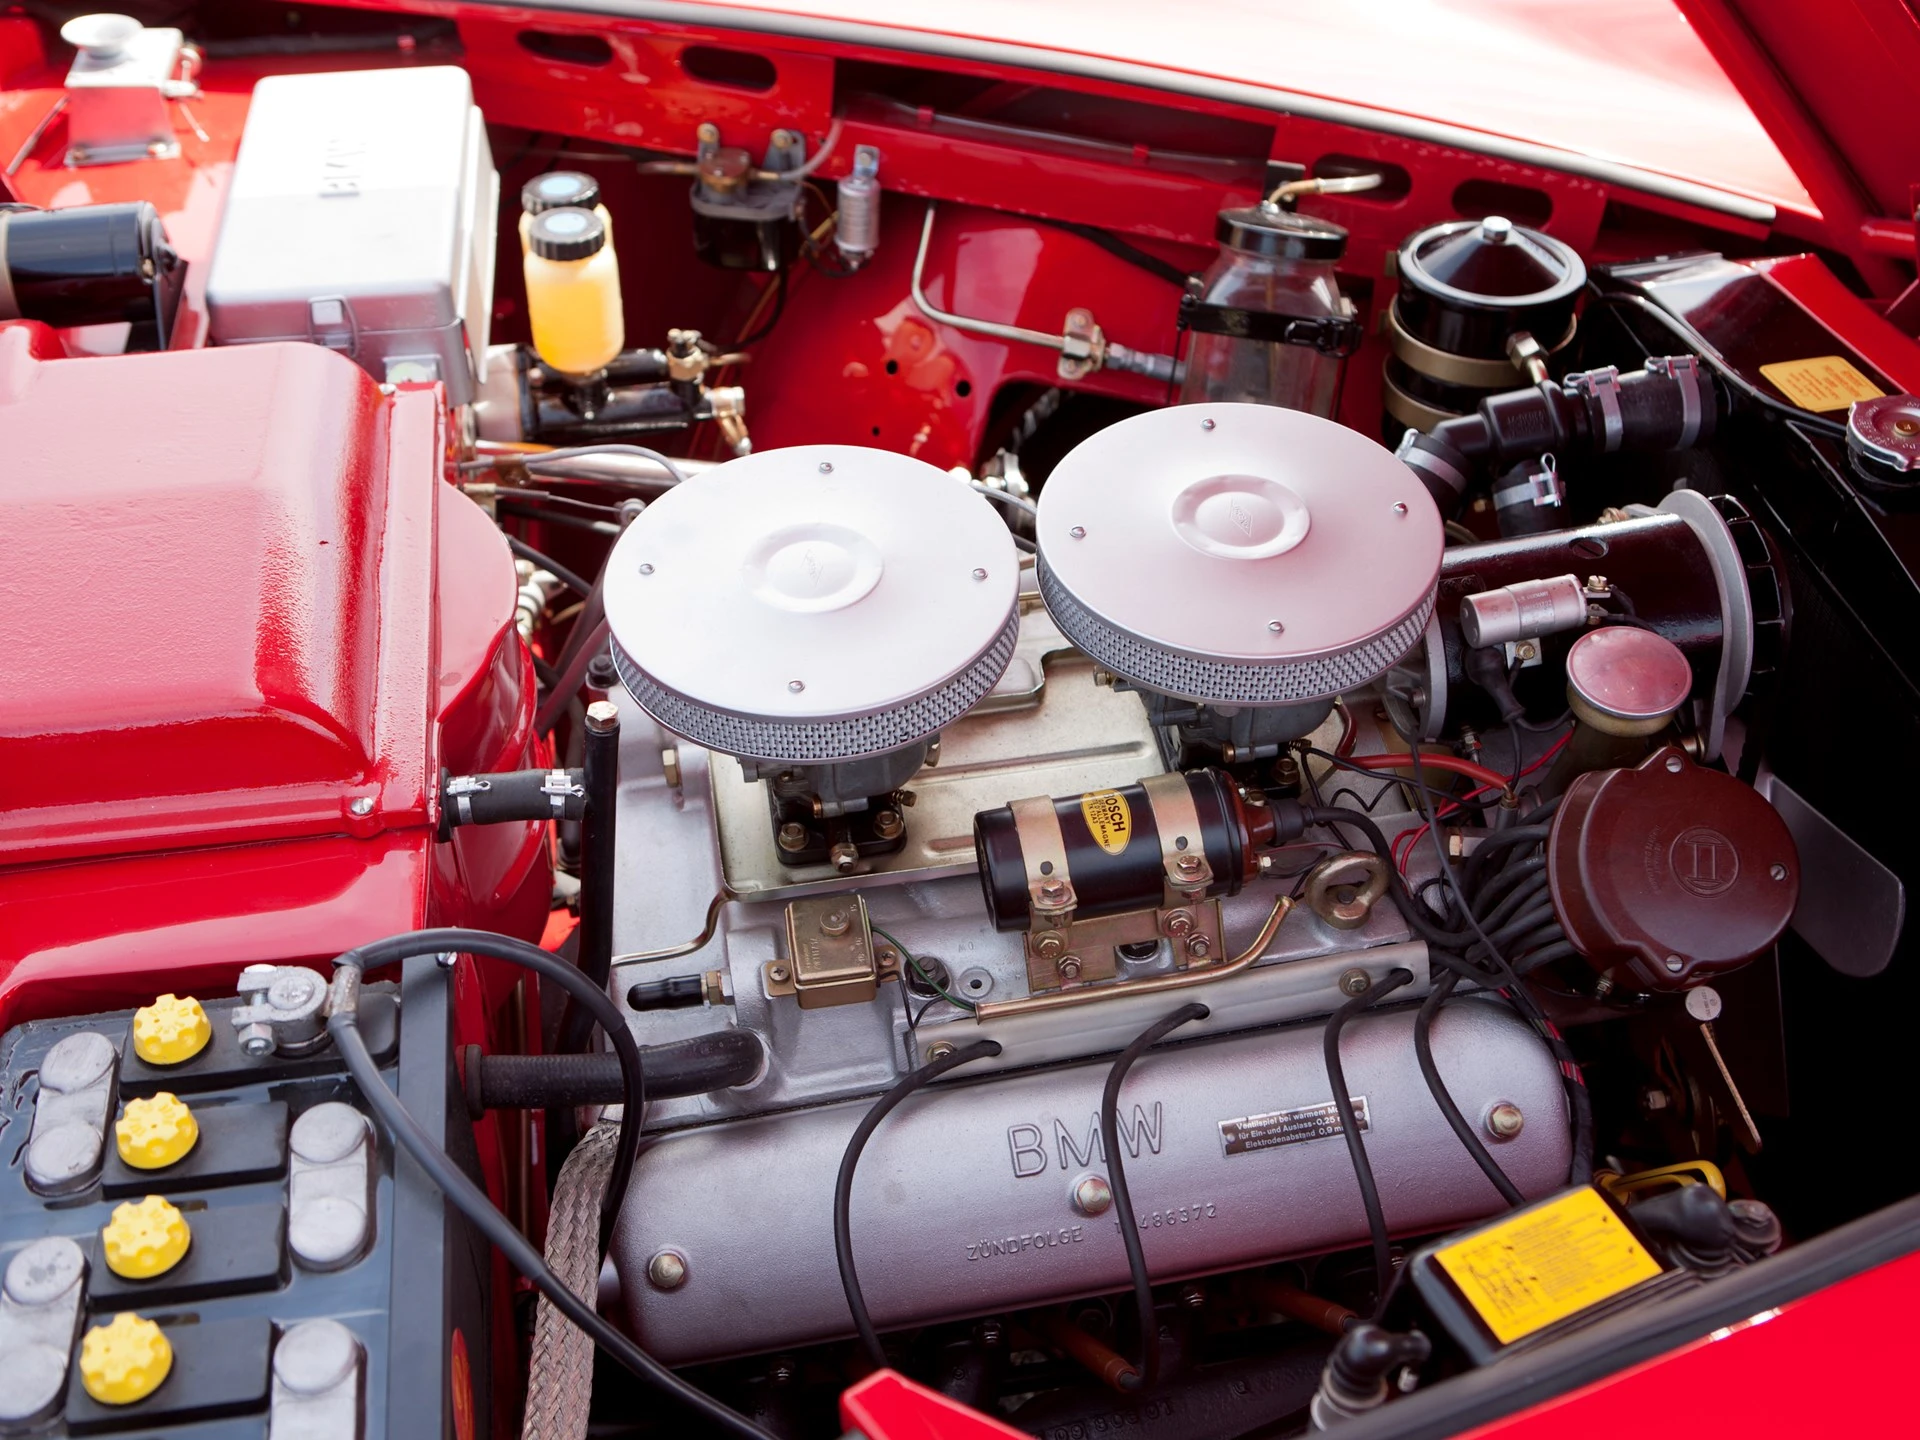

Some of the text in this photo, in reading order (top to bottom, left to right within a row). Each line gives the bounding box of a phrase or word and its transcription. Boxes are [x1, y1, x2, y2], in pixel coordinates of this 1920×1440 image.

[1236, 1117, 1278, 1130] Ventilspiel
[1279, 1115, 1292, 1123] bei
[1238, 1132, 1249, 1140] für
[1267, 1126, 1281, 1135] und
[1007, 1101, 1162, 1178] BMW
[1245, 1130, 1316, 1149] Elektrodenabstand
[1319, 1126, 1333, 1136] 0,9
[966, 1225, 1083, 1261] ZÜNDFOLGE
